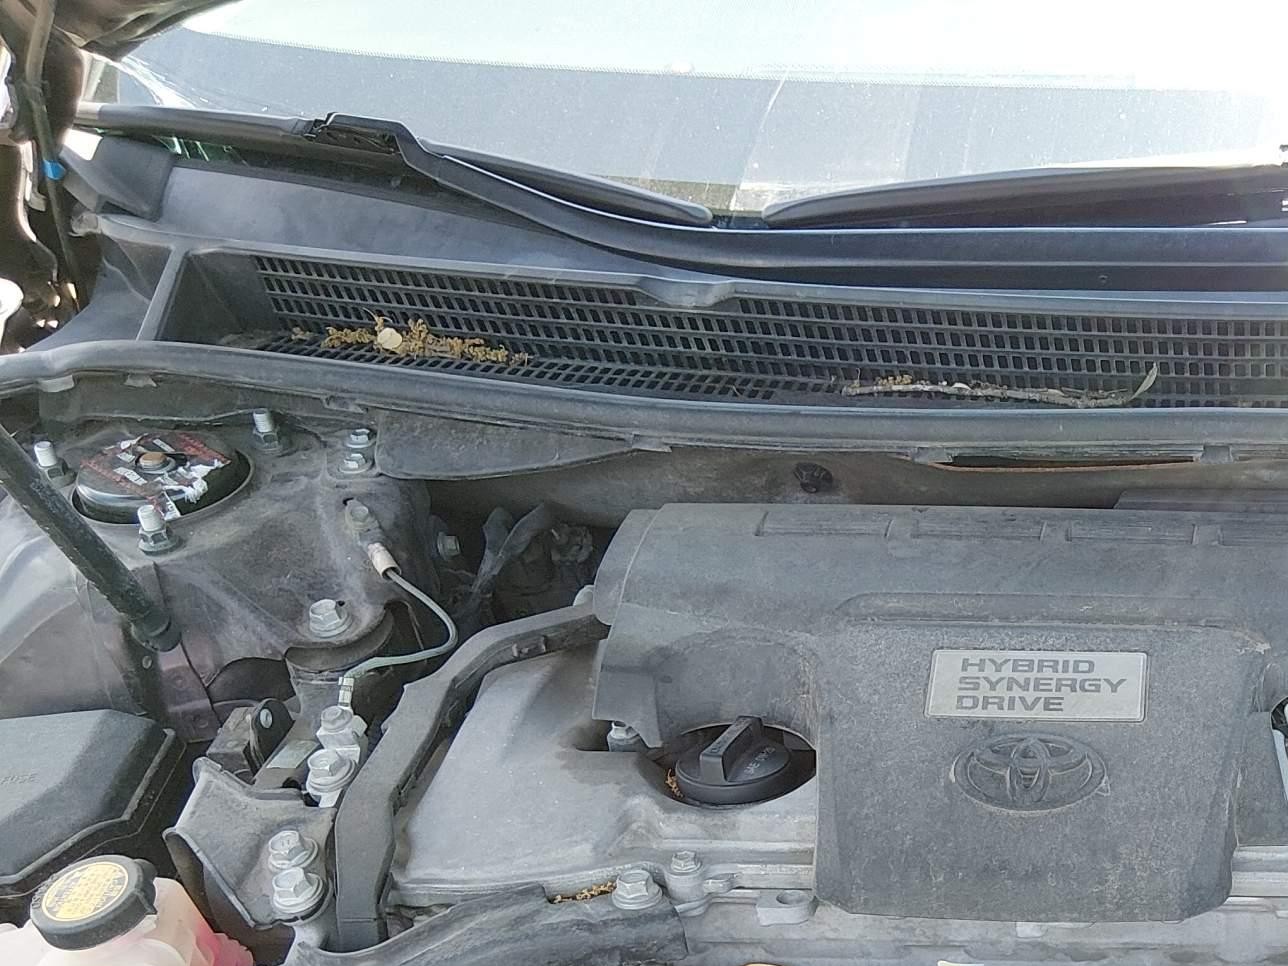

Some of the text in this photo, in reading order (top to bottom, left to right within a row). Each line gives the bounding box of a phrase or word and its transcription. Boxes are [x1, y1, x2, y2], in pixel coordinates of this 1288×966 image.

[961, 658, 1095, 673] HYBRID
[957, 676, 1127, 693] SYNERGY
[955, 695, 1065, 711] DRIVE
